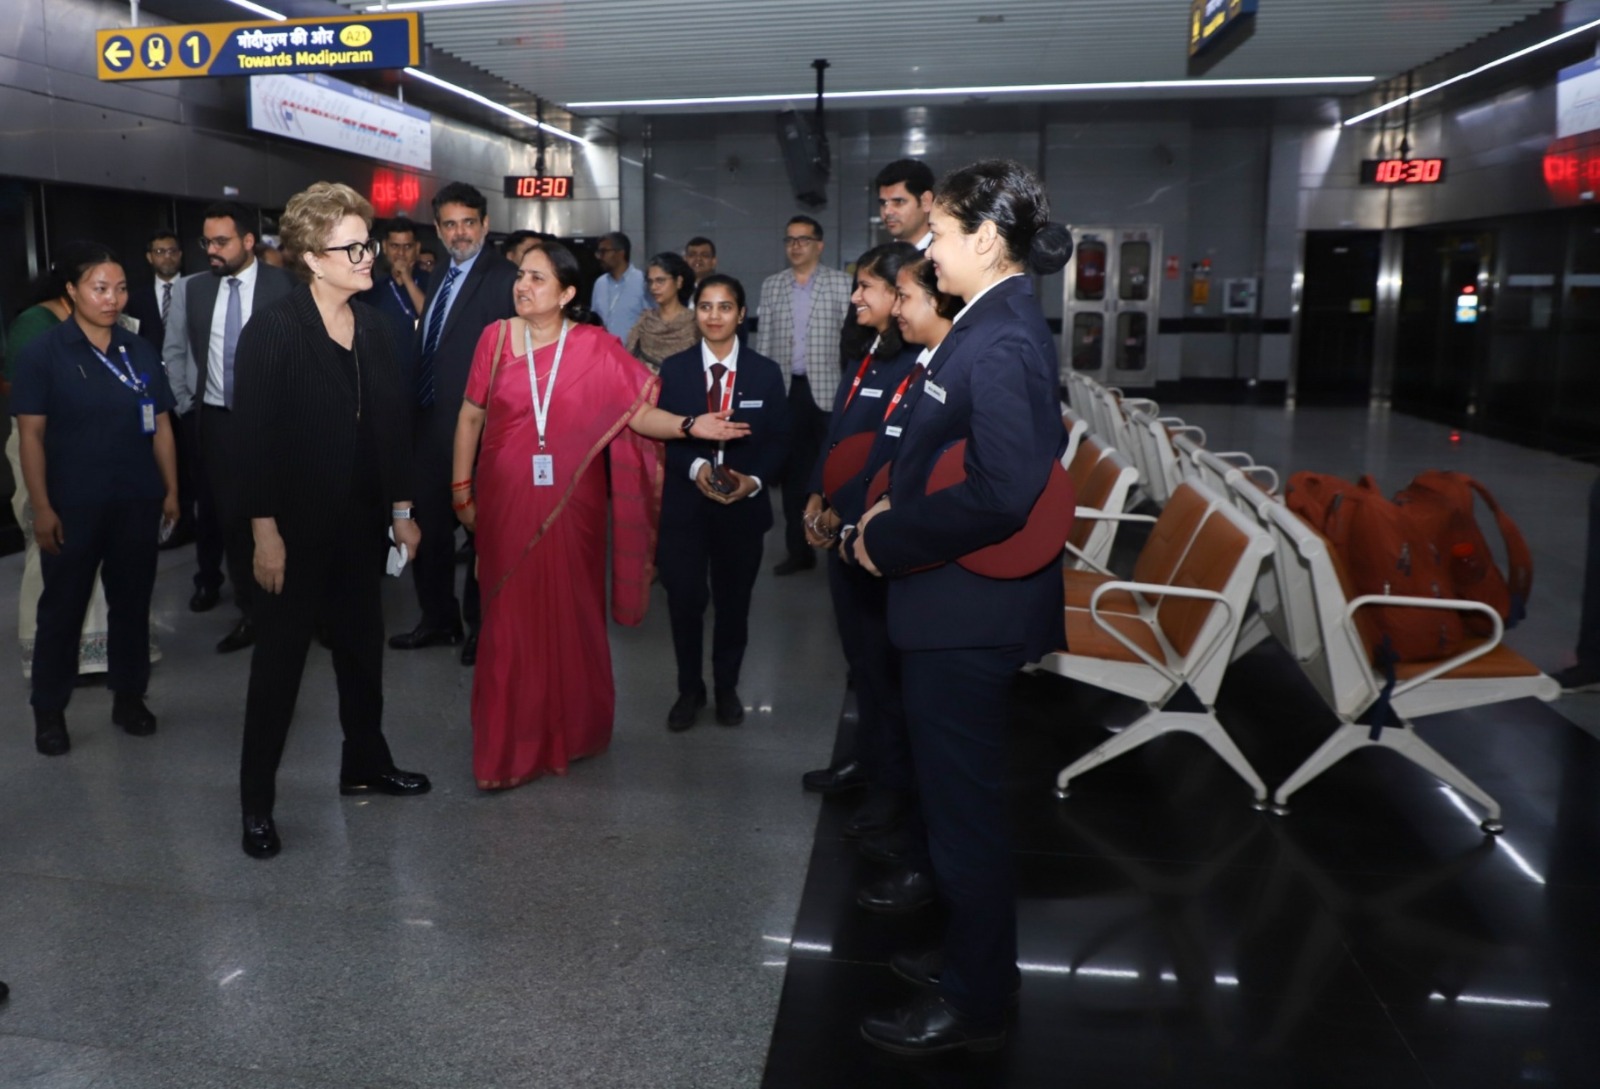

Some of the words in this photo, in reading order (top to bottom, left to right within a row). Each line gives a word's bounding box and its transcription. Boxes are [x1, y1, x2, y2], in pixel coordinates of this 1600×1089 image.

[237, 31, 288, 52] मोदीपुरम
[290, 27, 308, 46] की
[311, 26, 334, 45] ओर
[346, 31, 368, 42] A21
[186, 36, 200, 64] 1
[238, 53, 292, 68] Towards
[296, 49, 373, 66] Modipuram
[1376, 159, 1442, 183] 10:30
[517, 178, 567, 196] 10:30
